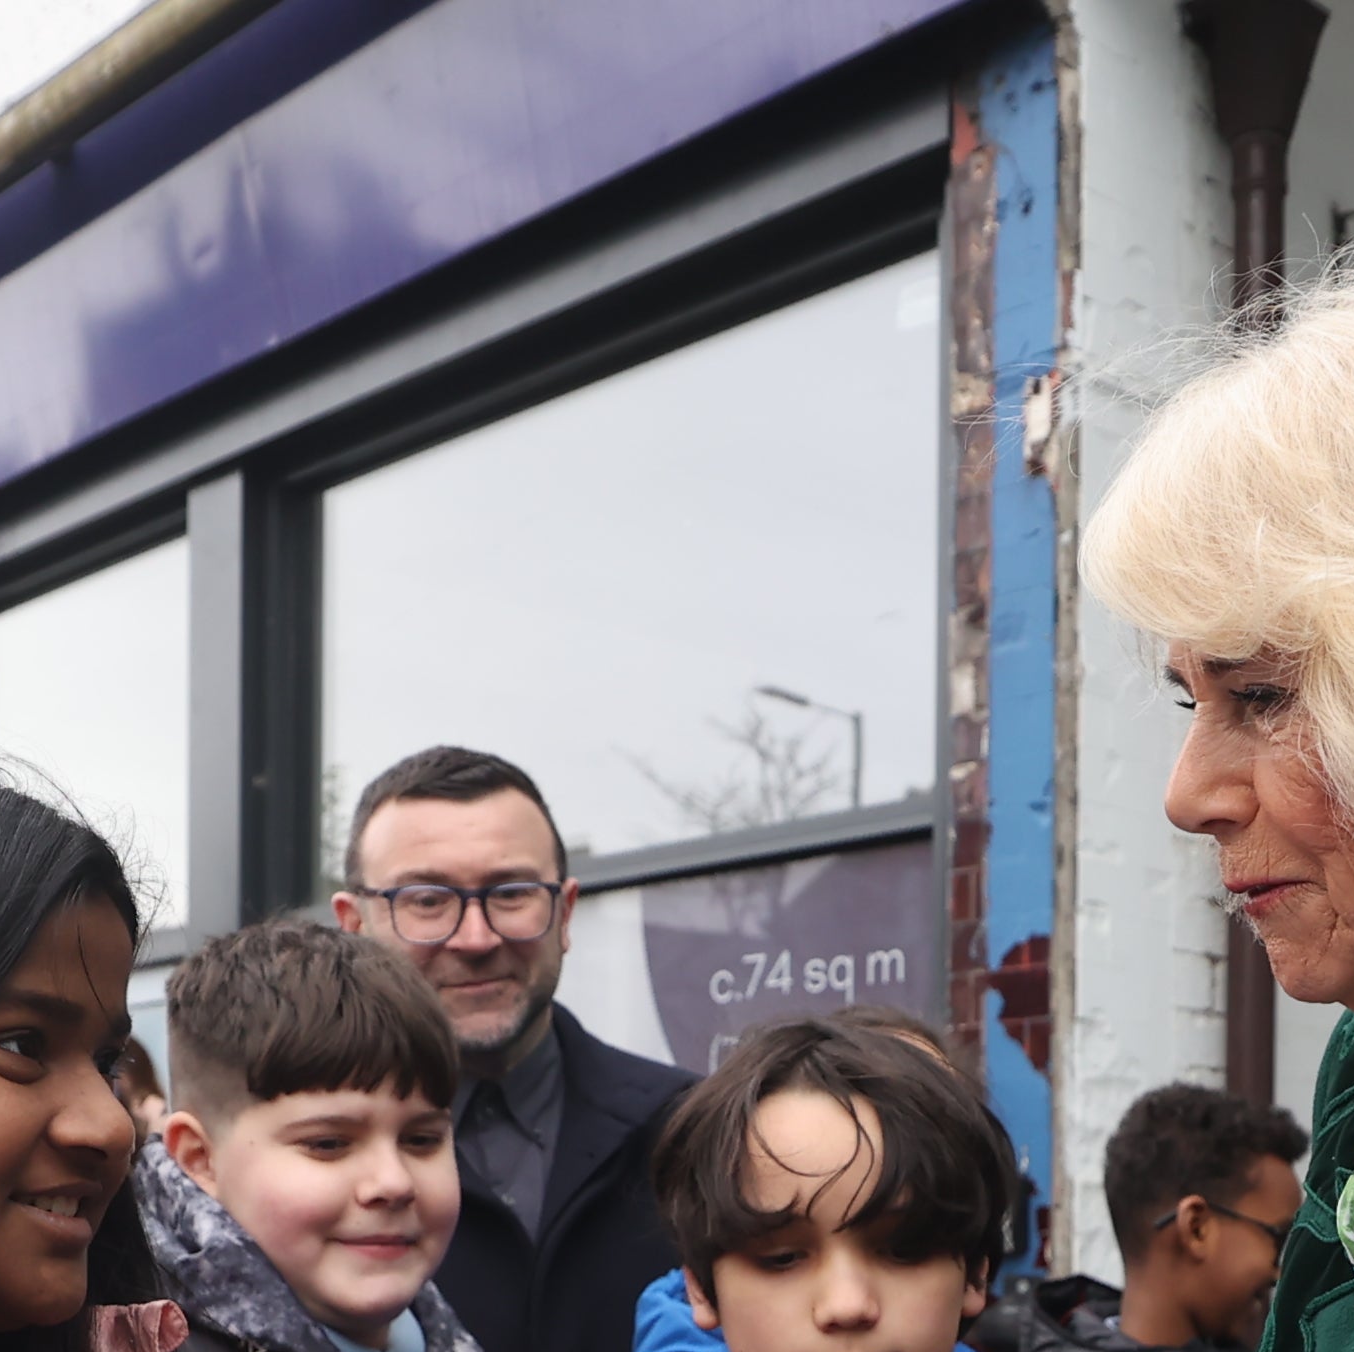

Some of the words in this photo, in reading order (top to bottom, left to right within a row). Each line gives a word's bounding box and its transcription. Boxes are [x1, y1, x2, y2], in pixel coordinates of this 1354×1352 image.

[709, 949, 793, 1005] c.74
[803, 954, 856, 1006] sq
[866, 947, 906, 987] m
